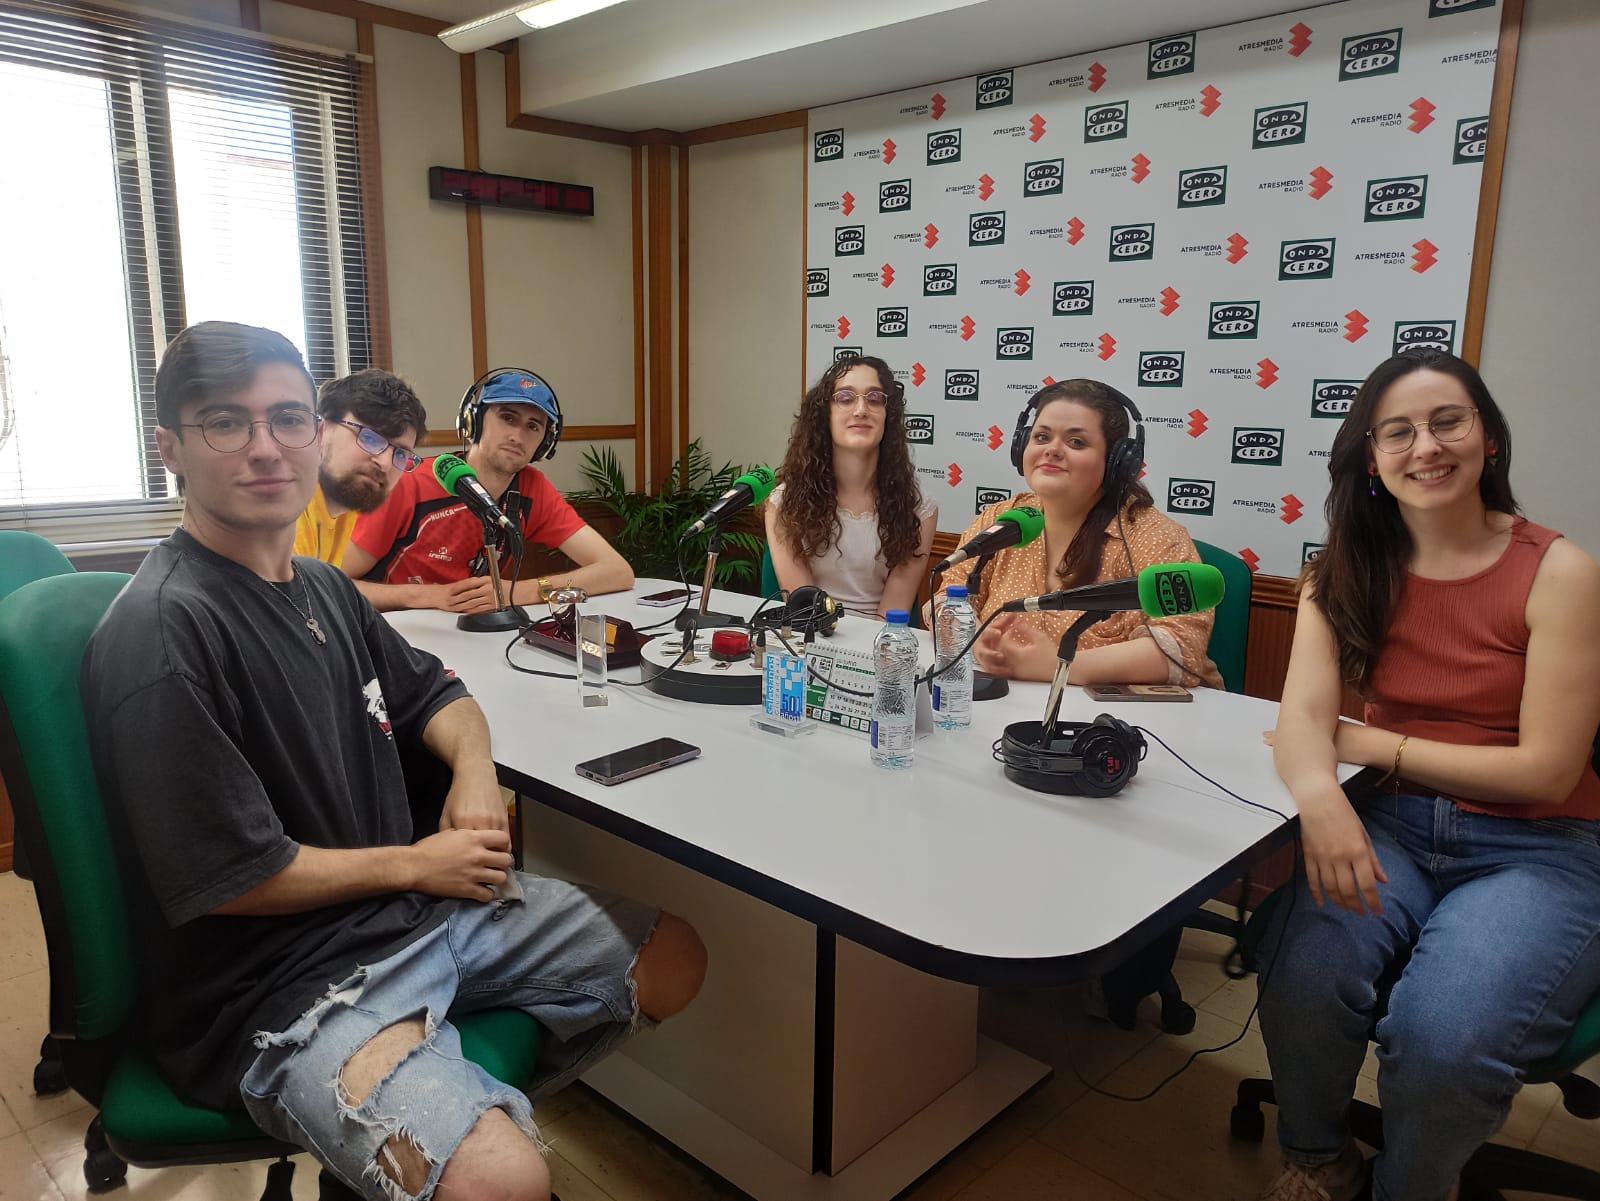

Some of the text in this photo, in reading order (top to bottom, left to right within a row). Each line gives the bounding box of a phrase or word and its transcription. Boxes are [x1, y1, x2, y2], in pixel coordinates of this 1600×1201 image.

[1239, 38, 1282, 51] ATRESMEDIA
[1264, 44, 1283, 52] RADIO
[1350, 40, 1389, 56] ONDA
[1155, 44, 1186, 56] ONDA
[1156, 57, 1186, 70] CERO
[1351, 56, 1389, 71] CERO
[982, 79, 1006, 90] ONDA
[1049, 75, 1084, 86] ATRESMEDIA
[983, 89, 1008, 99] CERO
[1155, 99, 1195, 109] ATRESMEDIA
[900, 105, 928, 114] ATRESMEDIA
[1091, 111, 1120, 122] ONDA
[1262, 113, 1297, 125] ONDA
[1351, 113, 1401, 125] ATRESMEDIA
[1380, 119, 1402, 127] RADIO
[993, 126, 1025, 136] ATRESMEDIA
[1092, 123, 1120, 134] CERO
[1263, 127, 1296, 140] CERO
[819, 136, 839, 145] ONDA
[932, 137, 956, 146] ONDA
[820, 146, 839, 156] CERO
[854, 149, 880, 157] ATRESMEDIA
[933, 148, 956, 158] CERO
[1030, 167, 1057, 177] ONDA
[1090, 166, 1126, 174] ATRESMEDIA
[1031, 179, 1056, 189] CERO
[1186, 176, 1218, 186] ONDA
[1259, 180, 1303, 189] ATRESMEDIA
[884, 186, 907, 195] ONDA
[1187, 188, 1218, 199] CERO
[1376, 186, 1416, 198] ONDA
[885, 197, 905, 206] CERO
[1377, 200, 1414, 212] CERO
[974, 218, 1001, 228] ONDA
[838, 232, 859, 240] ONDA
[976, 230, 1000, 240] CERO
[1117, 232, 1146, 241] ONDA
[840, 242, 860, 251] CERO
[1118, 244, 1146, 254] CERO
[1181, 245, 1221, 253] ATRESMEDIA
[1289, 248, 1324, 258] ONDA
[1356, 252, 1405, 260] ATRESMEDIA
[1290, 261, 1324, 272] CERO
[928, 270, 952, 279] ONDA
[930, 280, 952, 290] CERO
[1060, 289, 1087, 297] ONDA
[1060, 300, 1086, 309] CERO
[881, 313, 903, 321] ONDA
[1216, 310, 1250, 319] ONDA
[882, 323, 903, 332] CERO
[1217, 322, 1249, 332] CERO
[1002, 334, 1028, 342] ONDA
[1402, 330, 1444, 339] ONDA
[1003, 346, 1027, 354] CERO
[1147, 371, 1175, 379] CERO
[949, 376, 975, 384] ONDA
[950, 386, 974, 394] CERO
[1322, 388, 1358, 397] ONDA
[1322, 402, 1349, 411] CER
[906, 420, 929, 428] ONDA
[908, 430, 929, 438] CERO
[1241, 436, 1274, 444] ONDA
[1242, 449, 1274, 457] CERO
[1175, 487, 1206, 495] ONDA
[1176, 499, 1206, 507] CERO
[1233, 500, 1275, 508] ATRESMEDIA
[1162, 580, 1176, 612] CERO
[1176, 576, 1190, 611] ONDA
